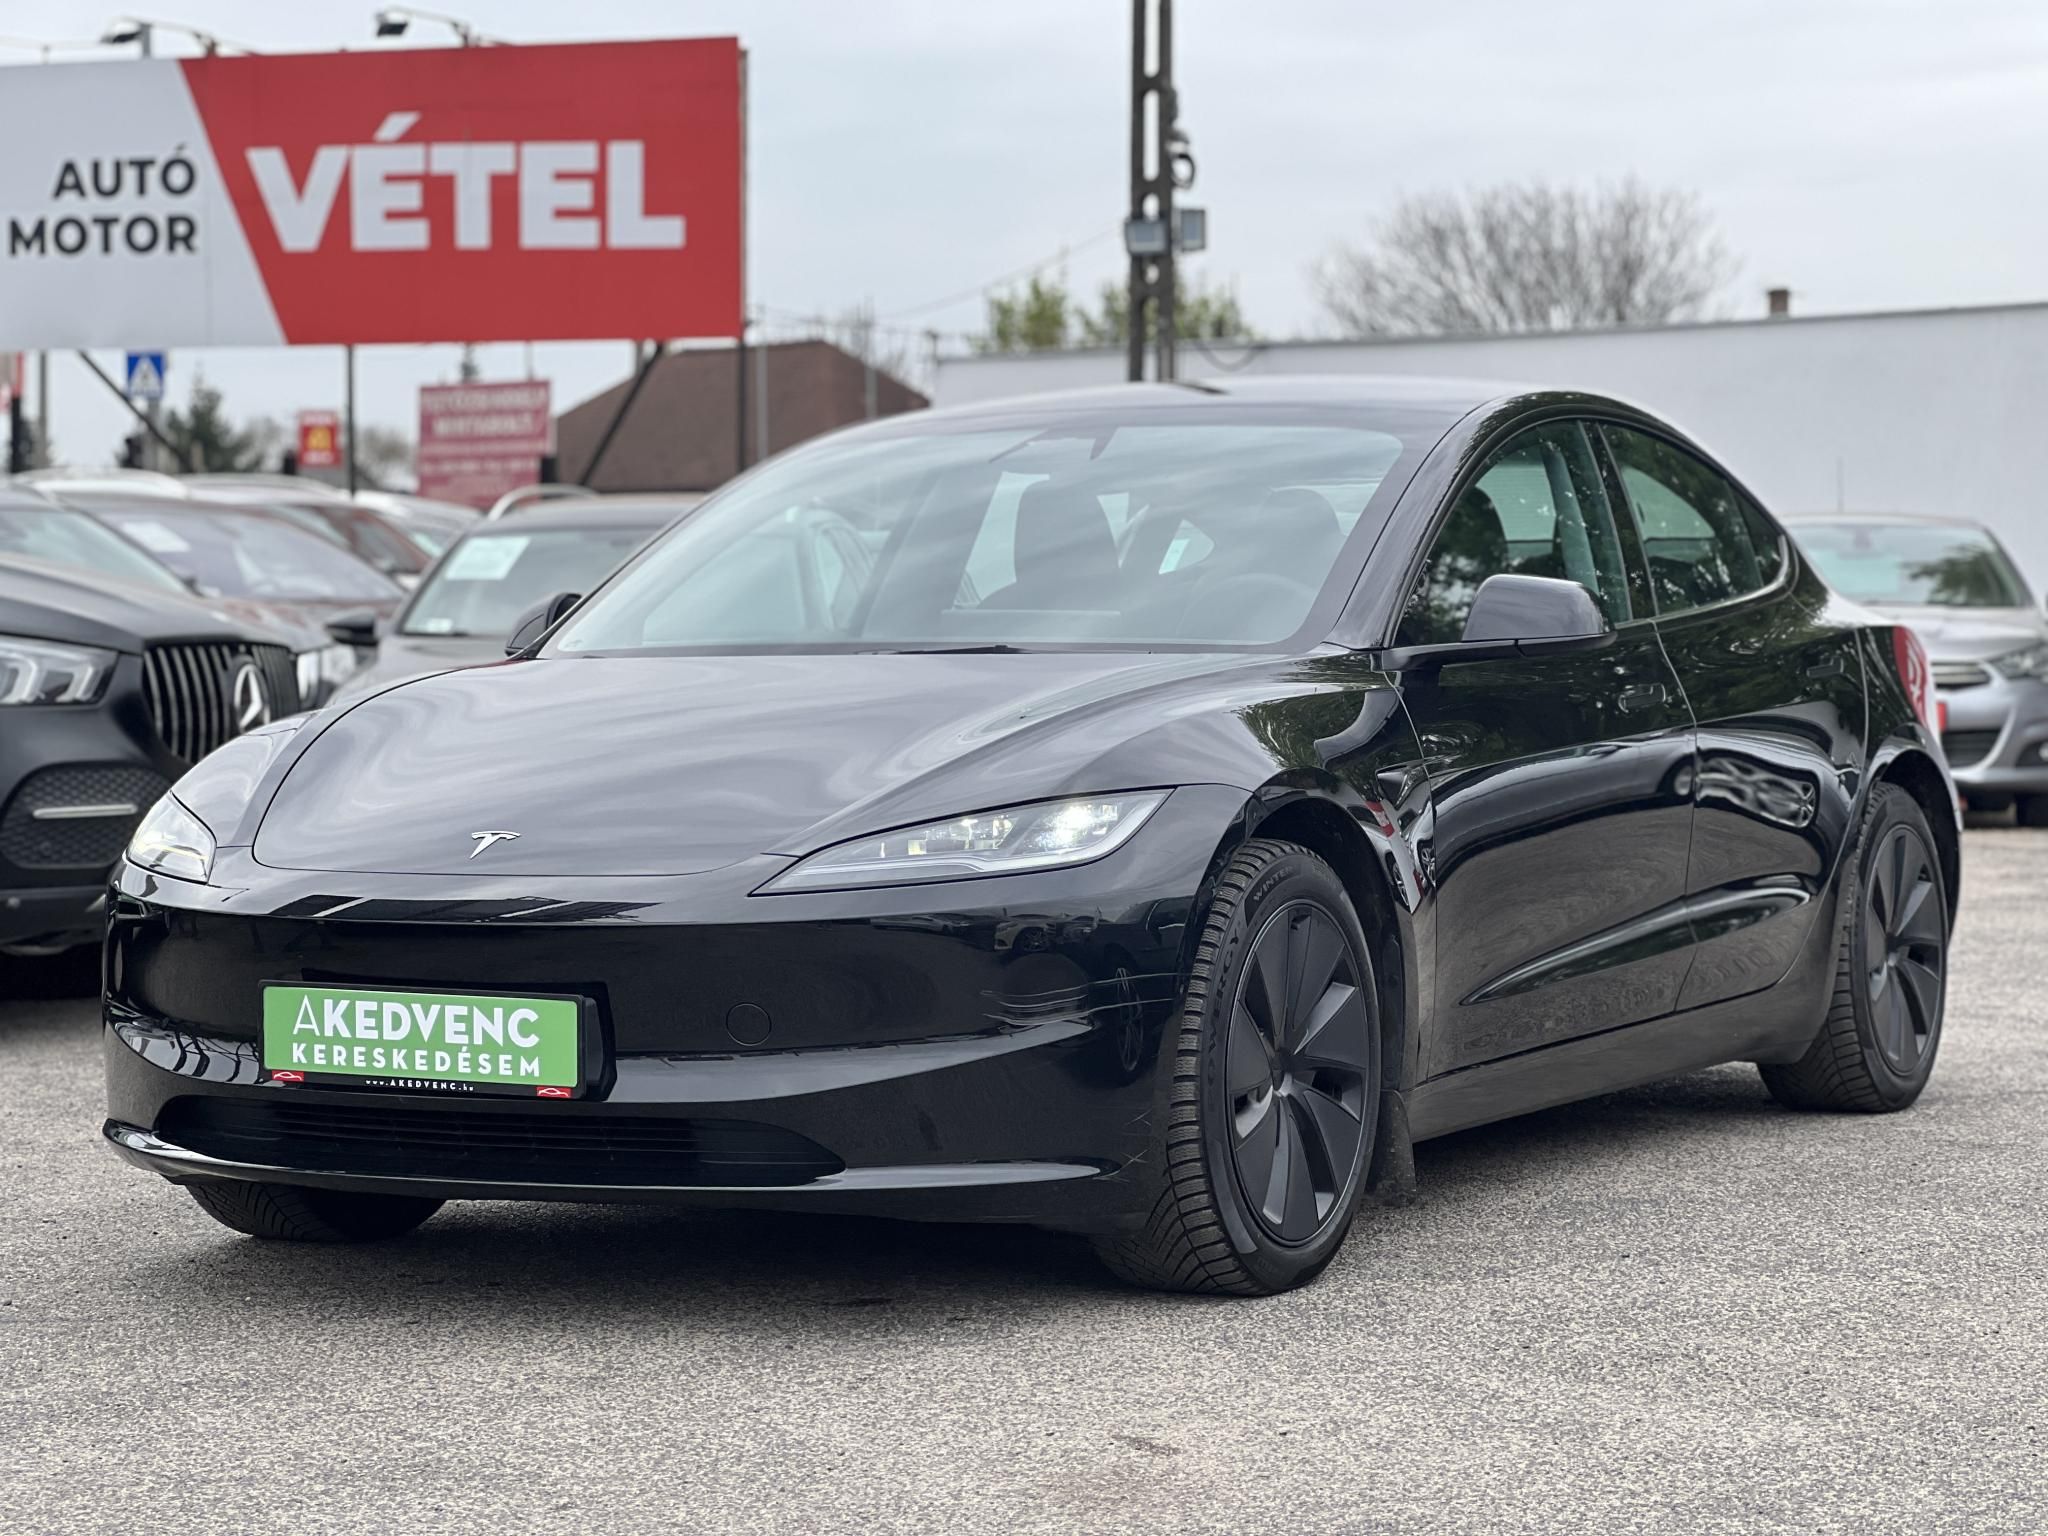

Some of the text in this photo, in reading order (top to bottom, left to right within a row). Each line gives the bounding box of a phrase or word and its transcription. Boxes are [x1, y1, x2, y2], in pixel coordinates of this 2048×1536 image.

[54, 143, 197, 199] AUTÓ
[246, 111, 686, 252] VÉTEL
[9, 215, 197, 256] MOTOR
[292, 994, 541, 1047] AKEDVENC
[292, 1042, 541, 1077] KERESKEDÉSEM
